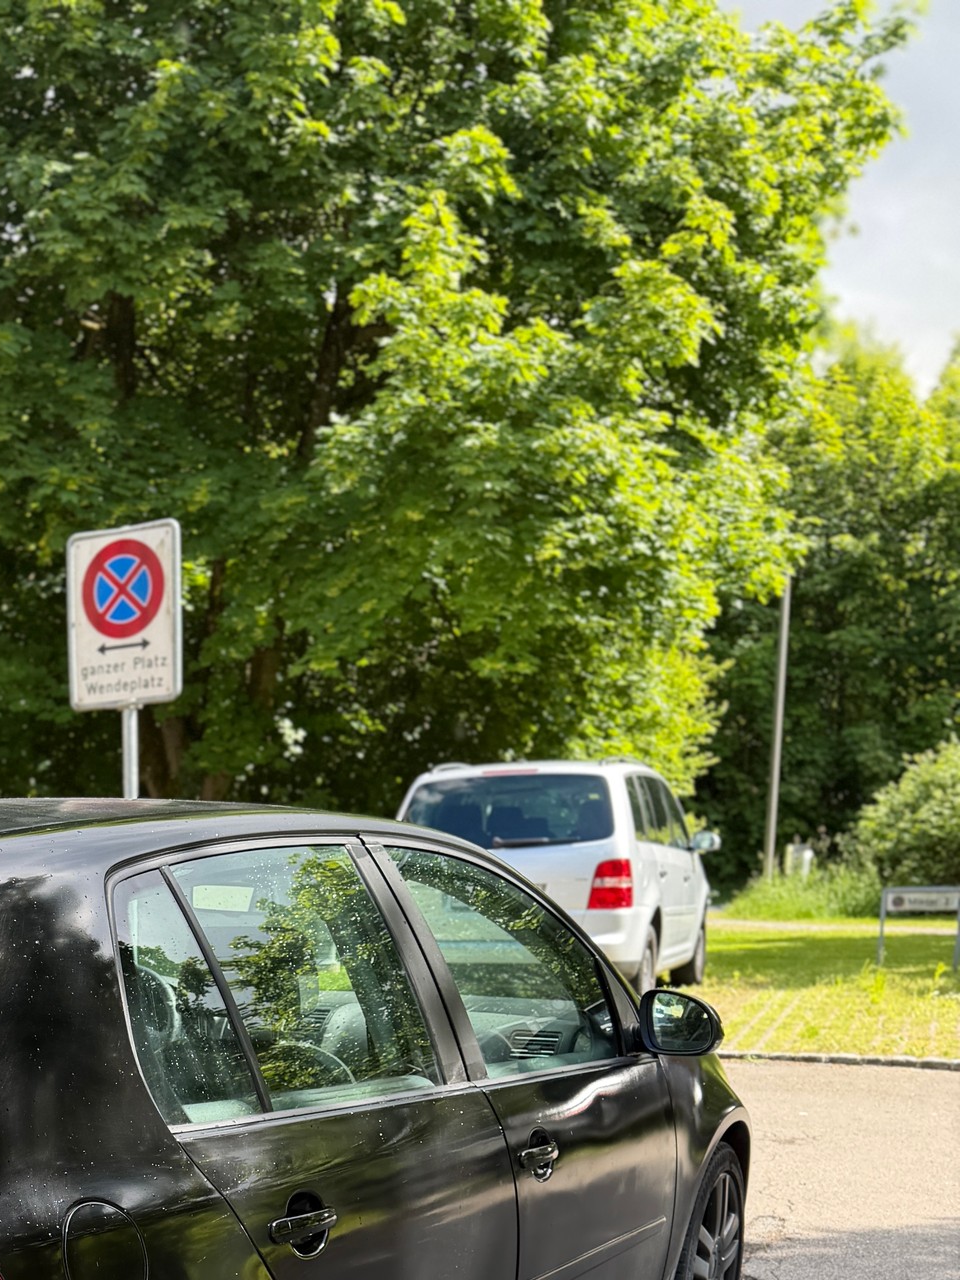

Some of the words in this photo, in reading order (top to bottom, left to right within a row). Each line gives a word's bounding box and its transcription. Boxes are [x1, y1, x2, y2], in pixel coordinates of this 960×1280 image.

[81, 661, 126, 681] ganzer
[133, 655, 167, 670] Platz
[85, 675, 164, 696] Wendeplatz
